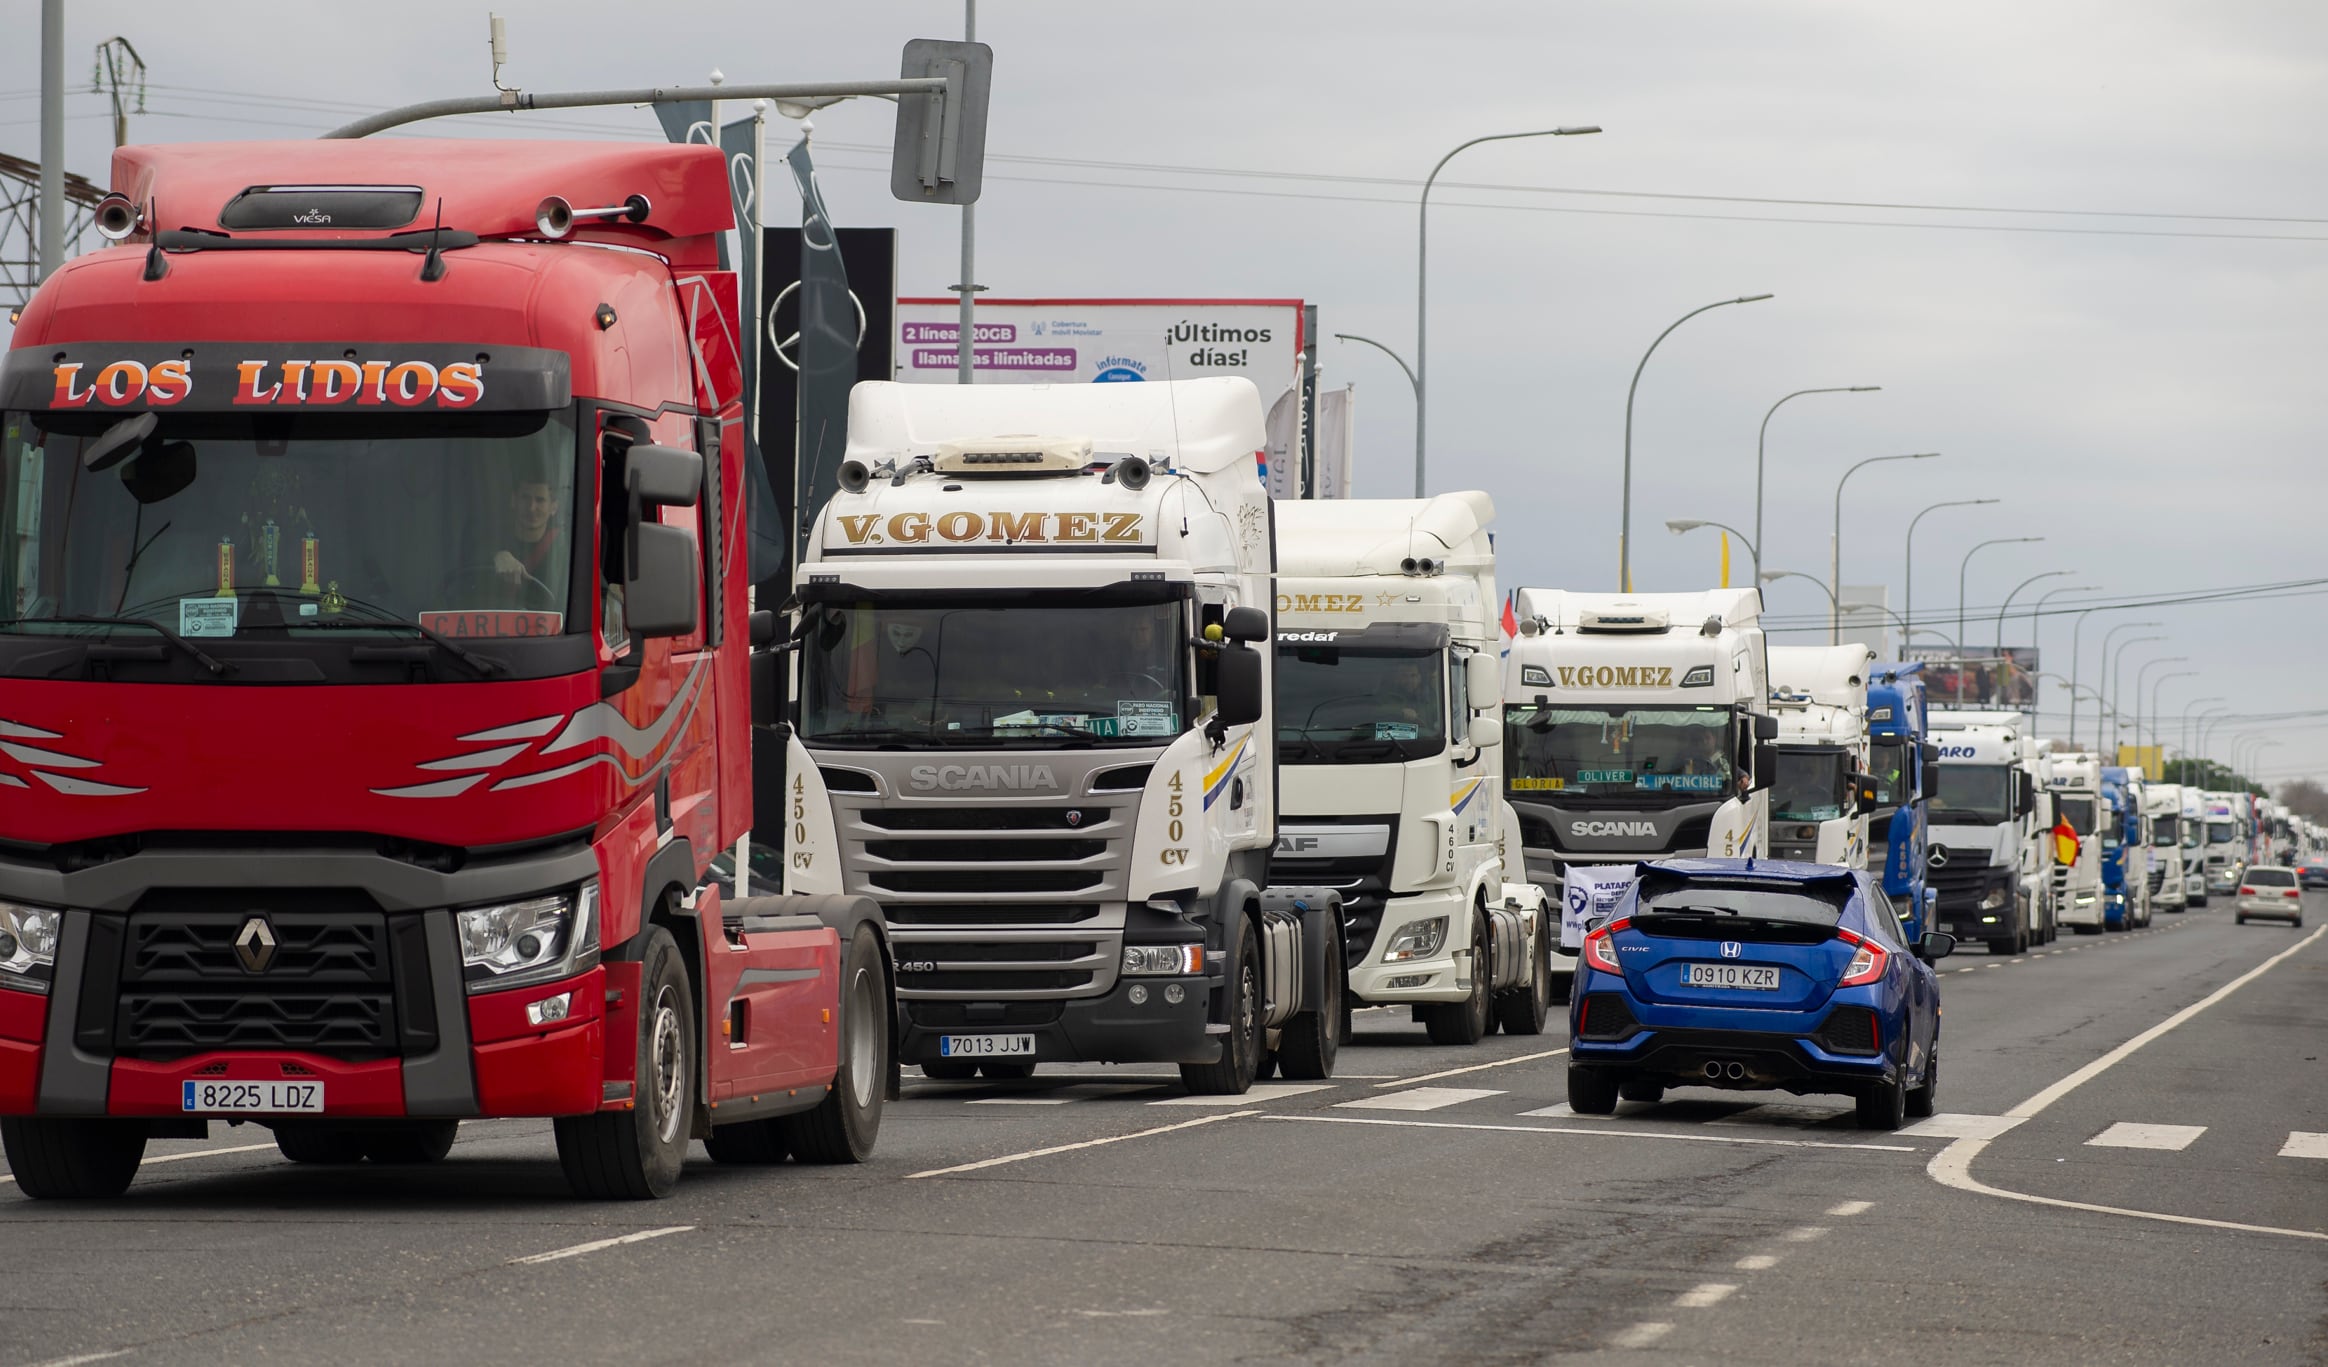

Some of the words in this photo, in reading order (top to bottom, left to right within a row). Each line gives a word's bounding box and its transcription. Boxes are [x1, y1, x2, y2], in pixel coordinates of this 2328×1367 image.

[906, 327, 916, 340] 2
[1166, 320, 1272, 345] ¡Últimos
[918, 351, 990, 365] llamaas
[993, 351, 1072, 366] ilimitadas
[1190, 348, 1248, 367] días!
[49, 360, 193, 409] LOS
[233, 360, 485, 409] LIDIOS
[836, 511, 1144, 545] V.GOMEZ
[1277, 594, 1364, 613] OMEZ
[434, 614, 548, 637] CARLOS
[1277, 631, 1339, 642] redaf
[1557, 665, 1674, 688] V.GOMEZ
[1938, 746, 1976, 758] ARO
[909, 764, 1059, 791] SCANIA
[1515, 779, 1561, 789] GLORIA
[1584, 771, 1625, 781] OLIVER
[1654, 776, 1723, 788] INVENCIBLE
[1167, 769, 1184, 842] 450
[1570, 821, 1658, 837] SCANIA
[1278, 838, 1319, 852] AF
[1724, 828, 1734, 858] 45
[1594, 881, 1632, 890] PLATAFO
[902, 961, 935, 972] 450
[1693, 967, 1736, 984] 0910
[1742, 969, 1774, 985] KZR
[952, 1038, 994, 1054] 7013
[1000, 1036, 1031, 1053] JJW
[203, 1085, 262, 1108] 8225
[271, 1085, 315, 1109] LDZ
